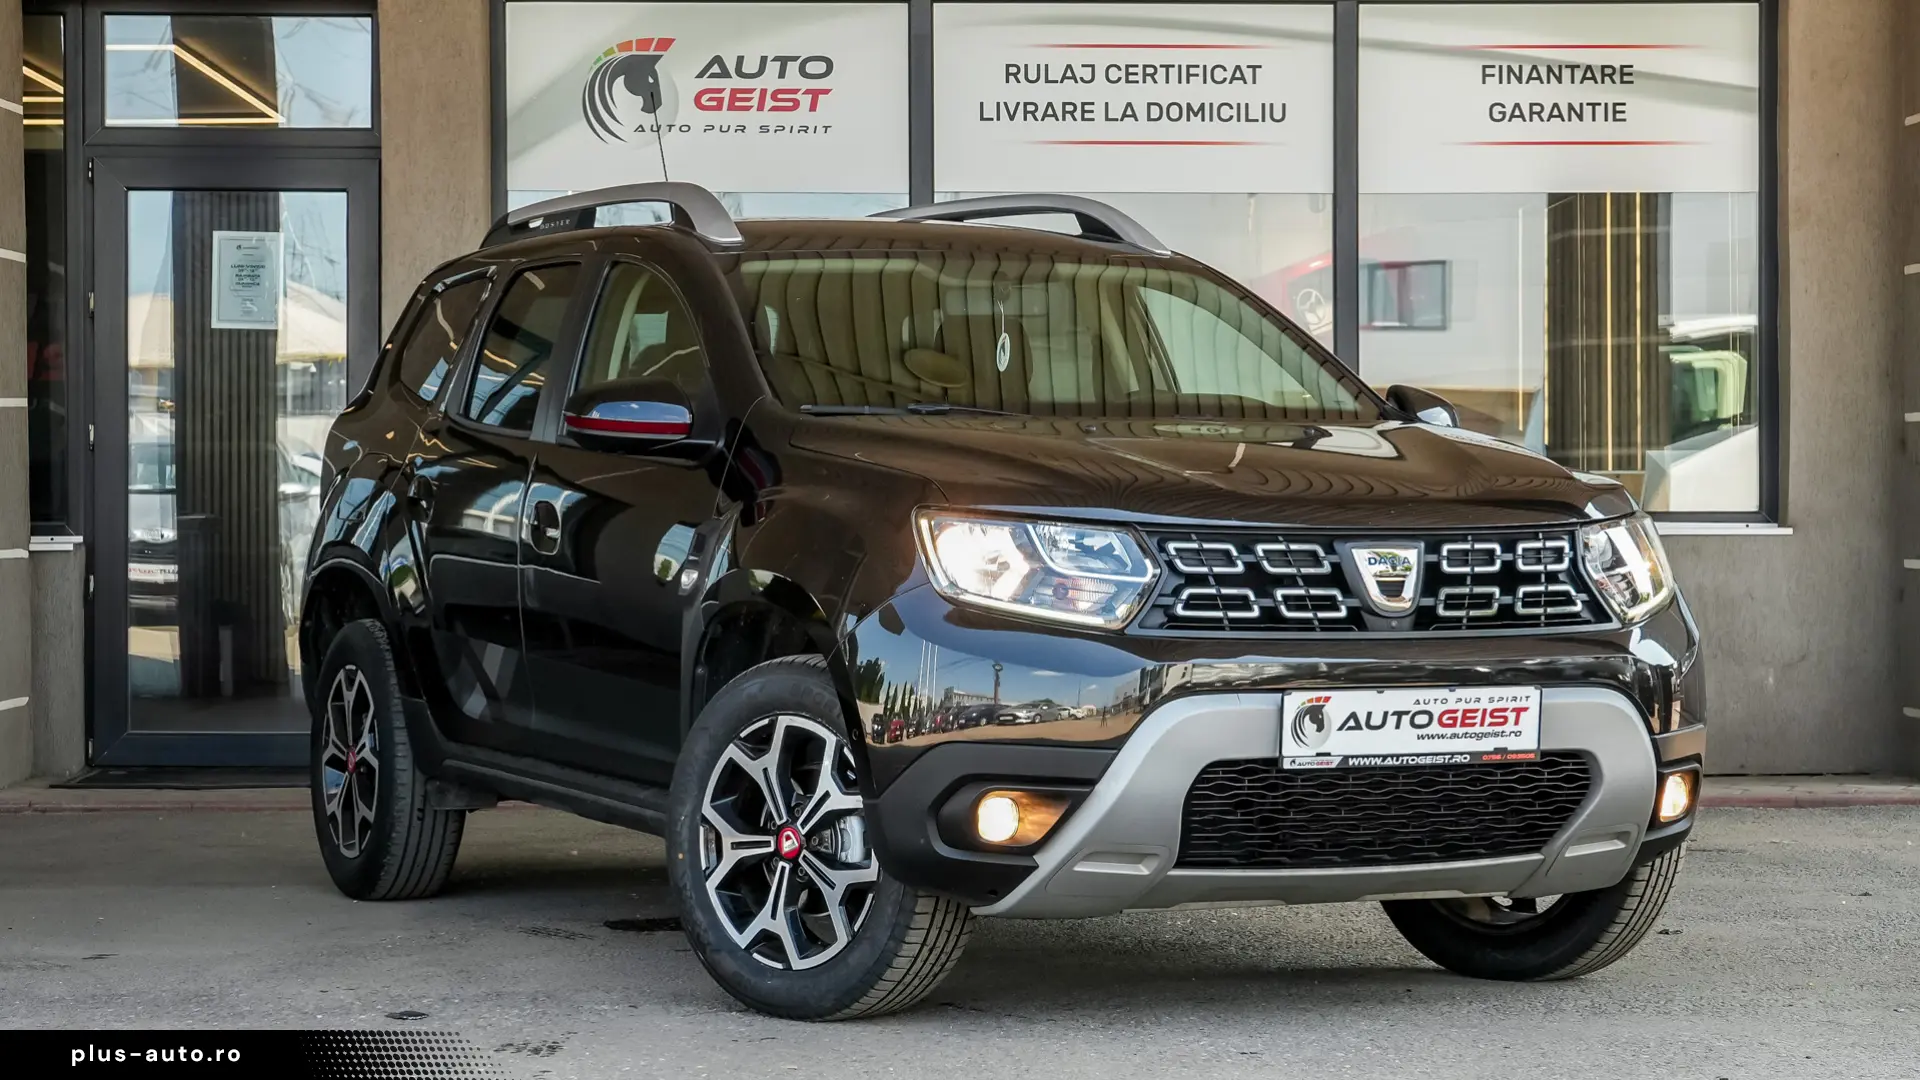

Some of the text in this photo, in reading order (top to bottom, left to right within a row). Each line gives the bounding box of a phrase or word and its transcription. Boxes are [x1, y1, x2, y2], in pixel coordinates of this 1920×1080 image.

[694, 54, 834, 80] AUTO
[1005, 63, 1262, 85] RULAJ CERTIFICAT
[1481, 64, 1635, 85] FINANTARE
[693, 87, 834, 113] GEIST
[979, 101, 1287, 123] LIVRARE LA DOMICILIU
[1488, 102, 1628, 123] GARANTIE
[633, 124, 833, 134] AUTO PUR SPIRIT
[1368, 556, 1411, 566] DACIA
[1488, 695, 1531, 704] SPIRIT
[1416, 730, 1523, 741] www.autogeist.ro
[1348, 755, 1470, 765] WWW.AUTOGEIST.RO
